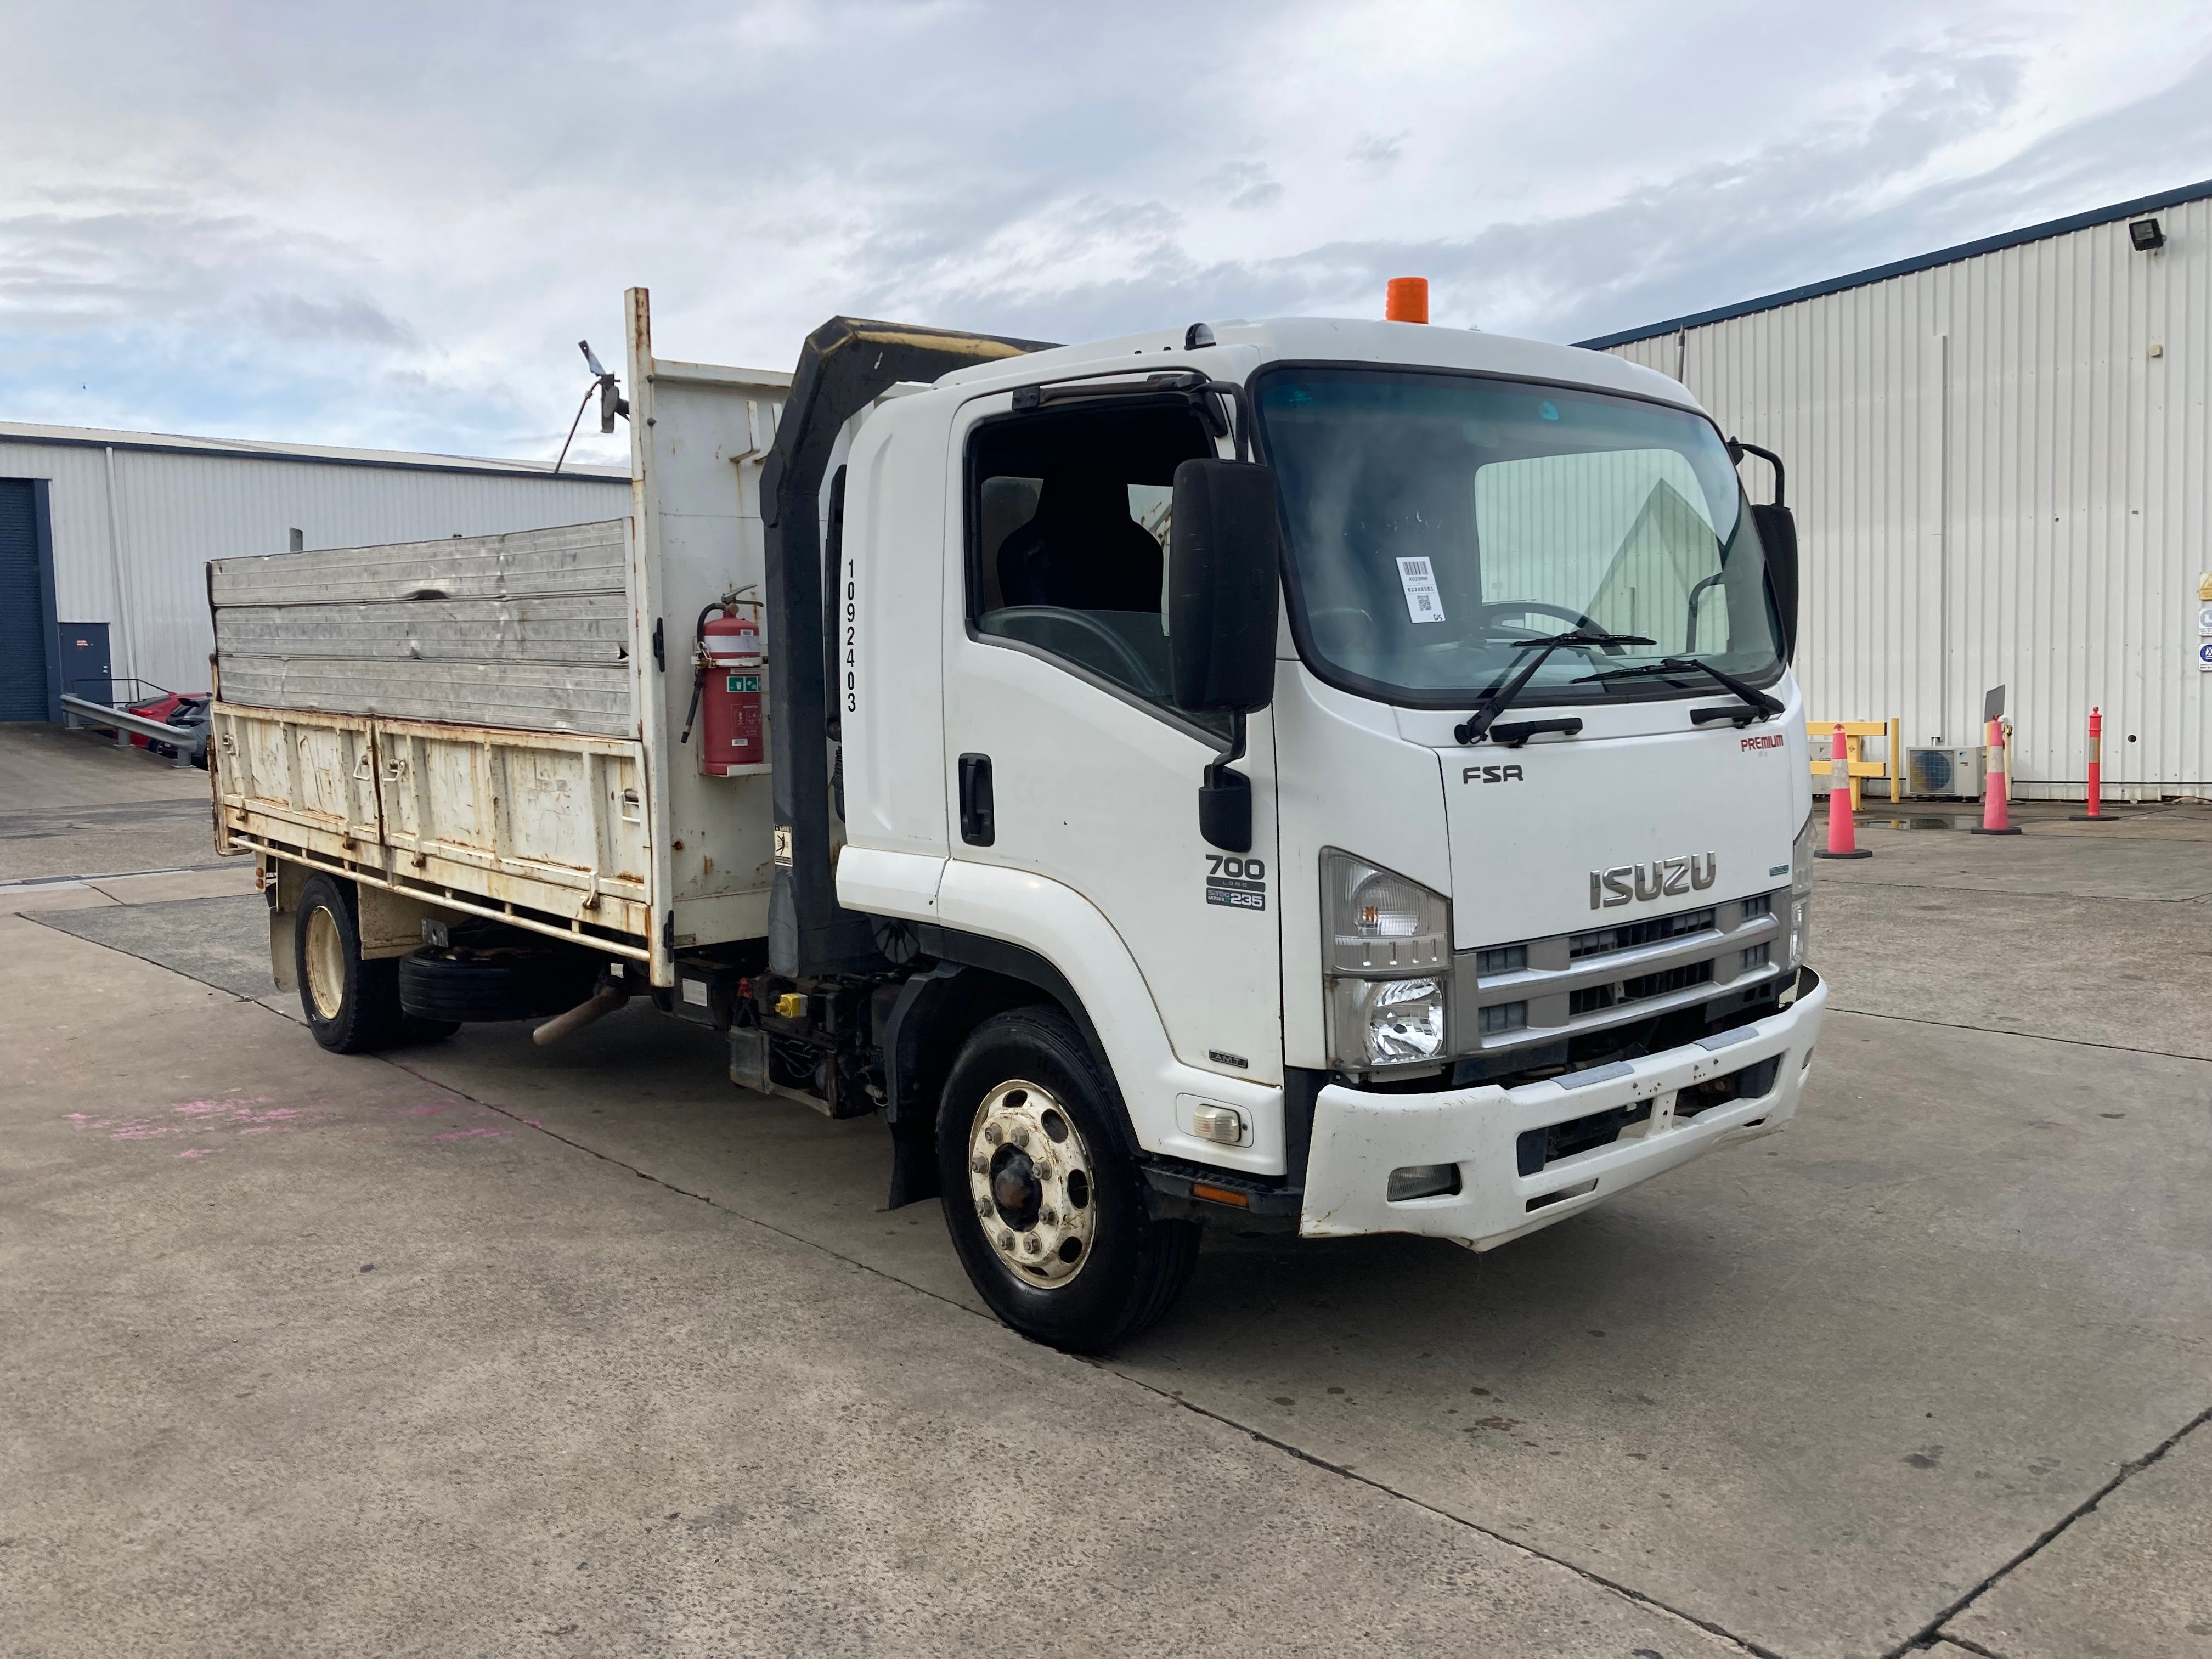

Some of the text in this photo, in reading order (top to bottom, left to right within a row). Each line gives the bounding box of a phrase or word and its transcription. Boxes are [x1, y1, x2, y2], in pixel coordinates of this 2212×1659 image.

[847, 558, 856, 712] 1092403
[1741, 734, 1784, 752] PREMIUM
[1463, 765, 1523, 785] FSR
[1205, 854, 1265, 880] 700
[1590, 850, 1716, 910] ISUZU
[1231, 893, 1262, 907] 235
[1215, 1053, 1240, 1064] AMT
